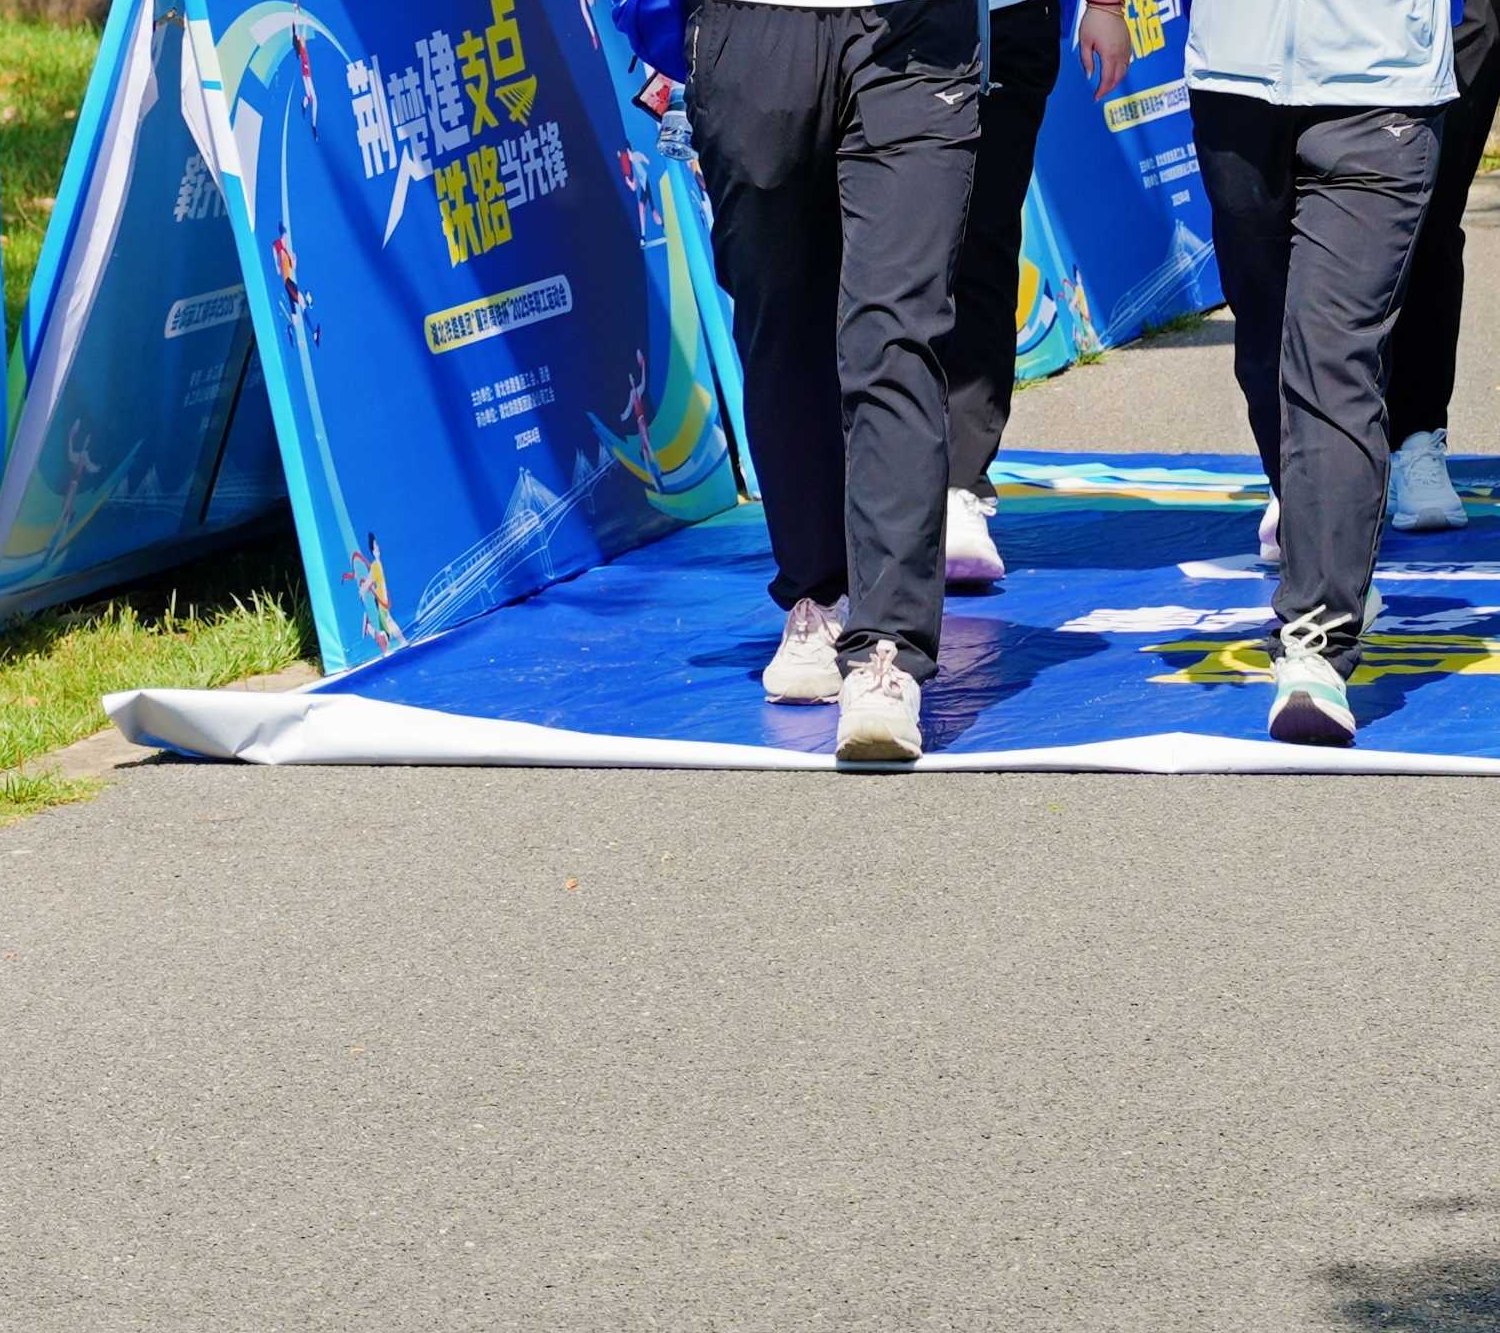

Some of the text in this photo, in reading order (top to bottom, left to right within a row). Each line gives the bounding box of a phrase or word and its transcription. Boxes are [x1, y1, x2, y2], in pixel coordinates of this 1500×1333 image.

[435, 121, 569, 269] 铁路当先锋
